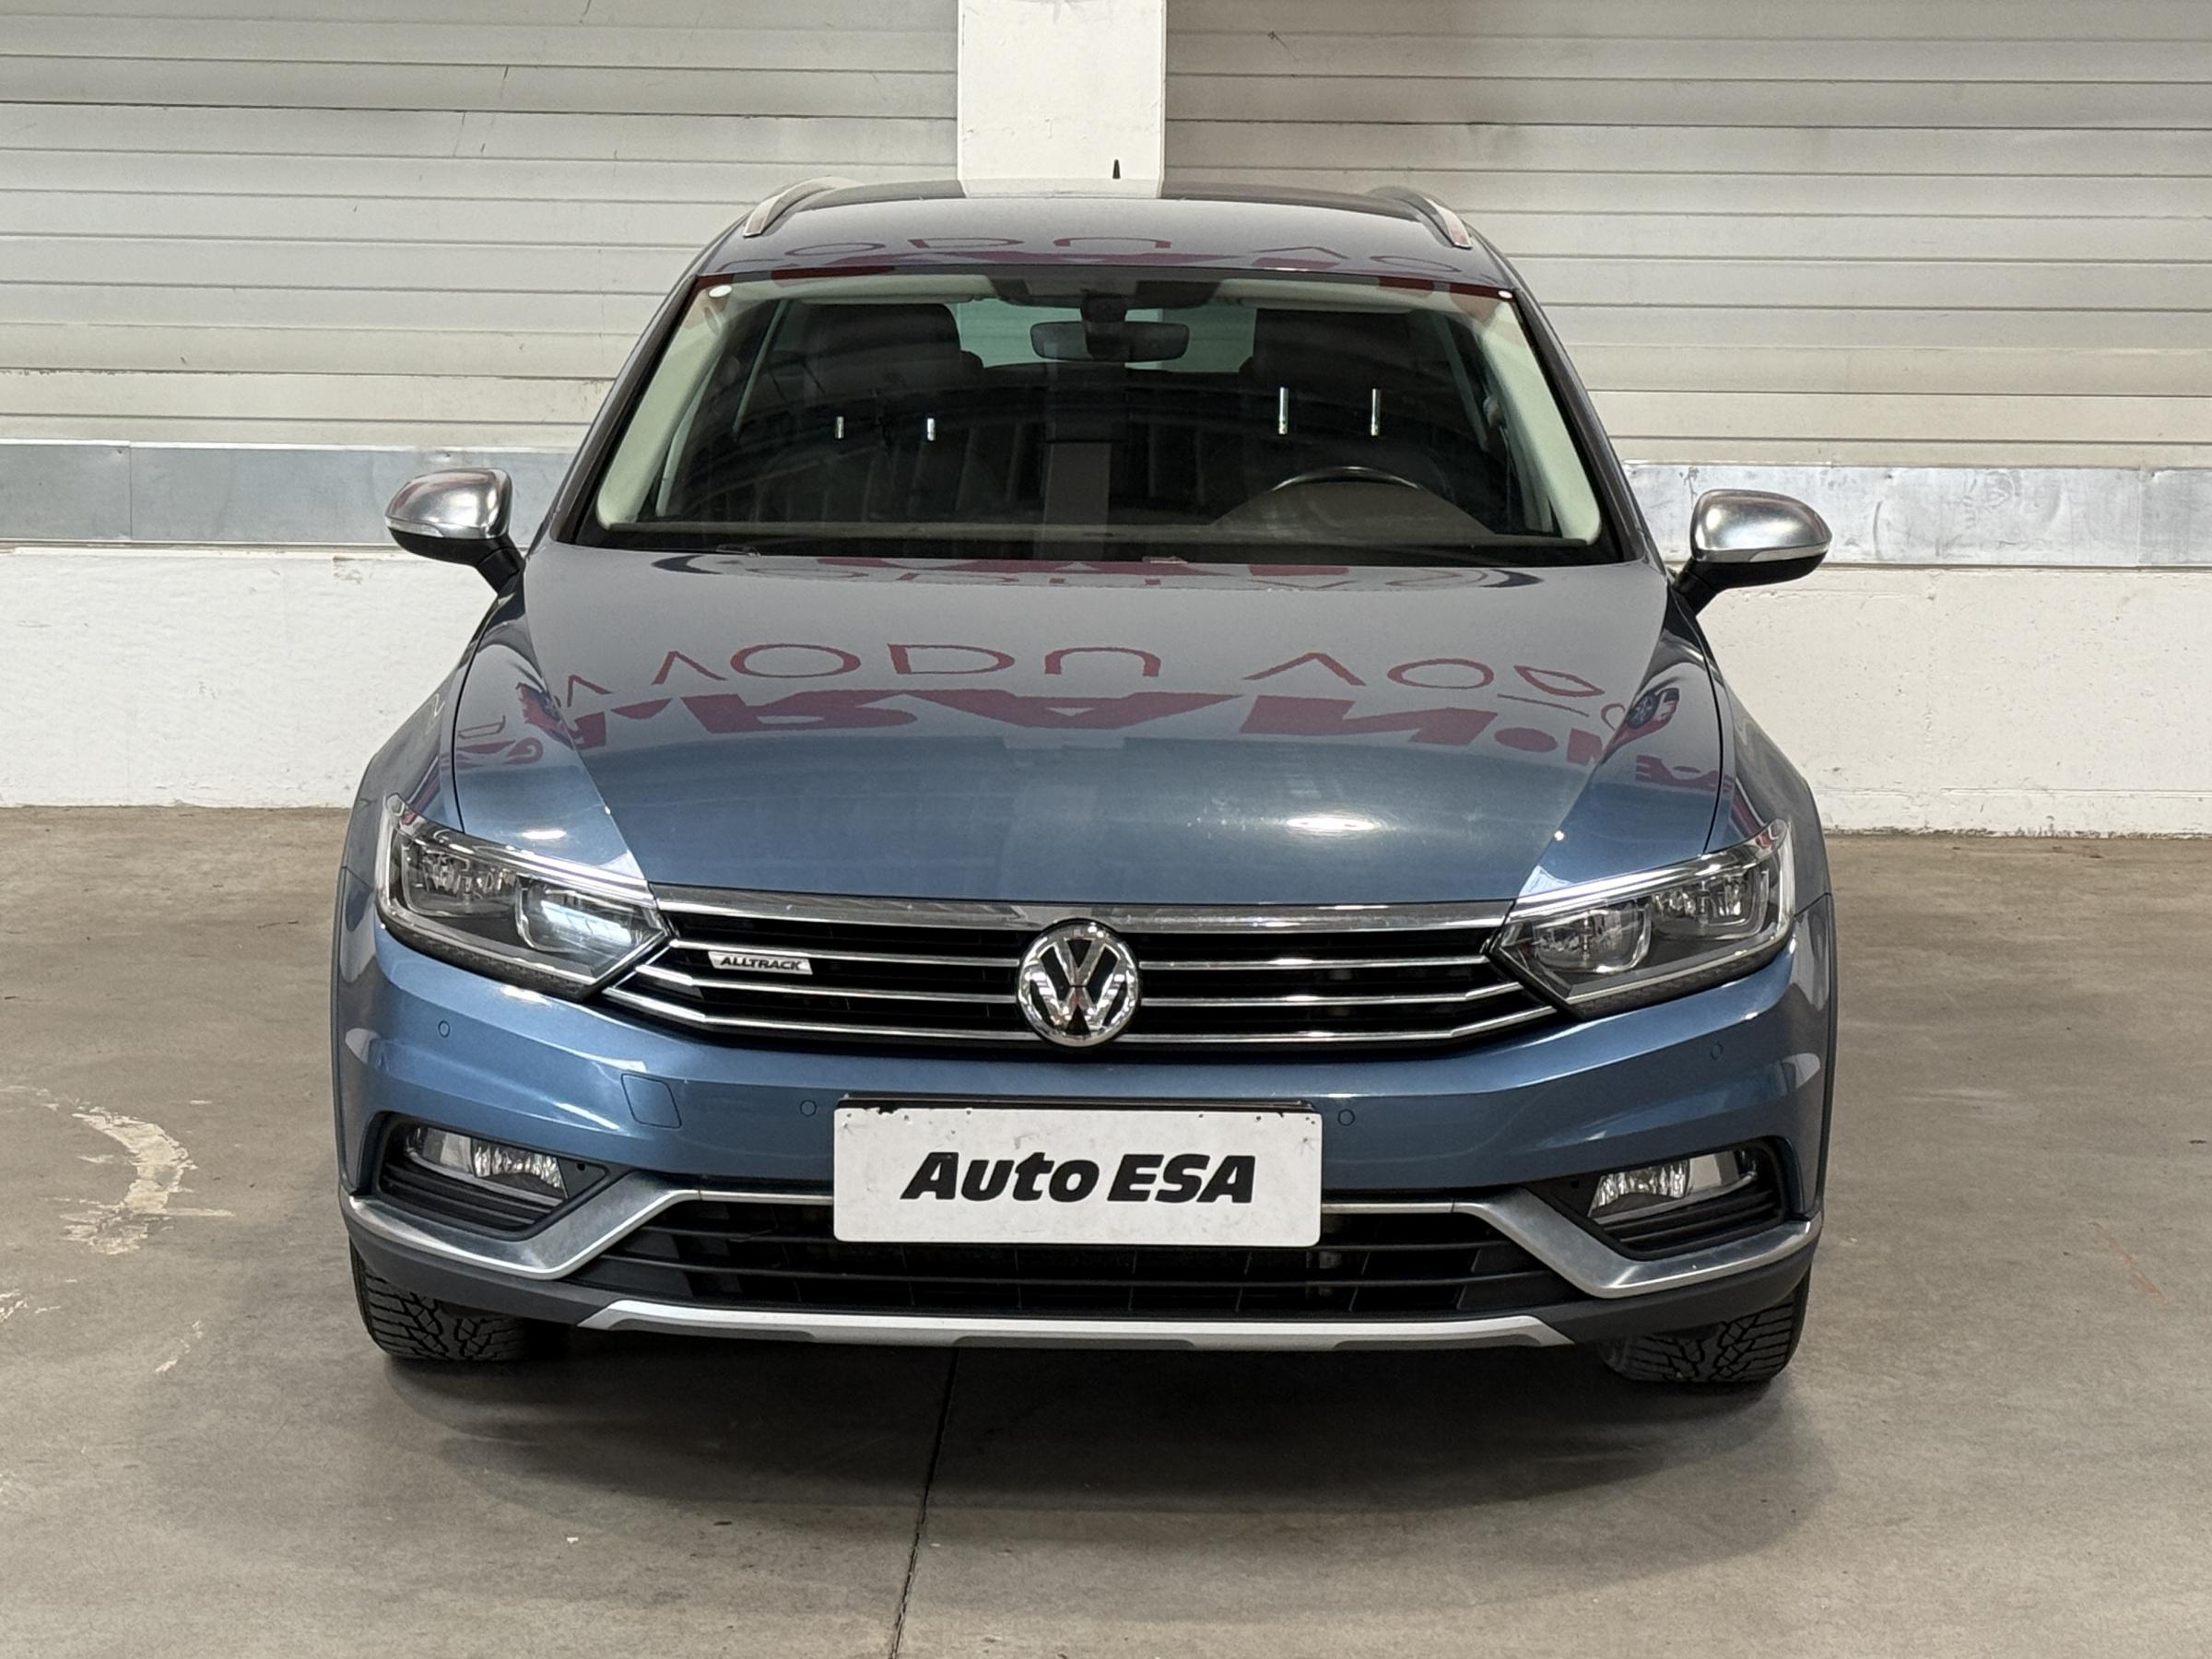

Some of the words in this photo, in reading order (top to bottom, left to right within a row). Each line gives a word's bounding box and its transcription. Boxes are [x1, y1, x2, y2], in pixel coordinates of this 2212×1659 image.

[720, 956, 802, 971] ALLTRACK
[900, 1151, 1100, 1203] Auto
[1106, 1153, 1256, 1204] ESA
